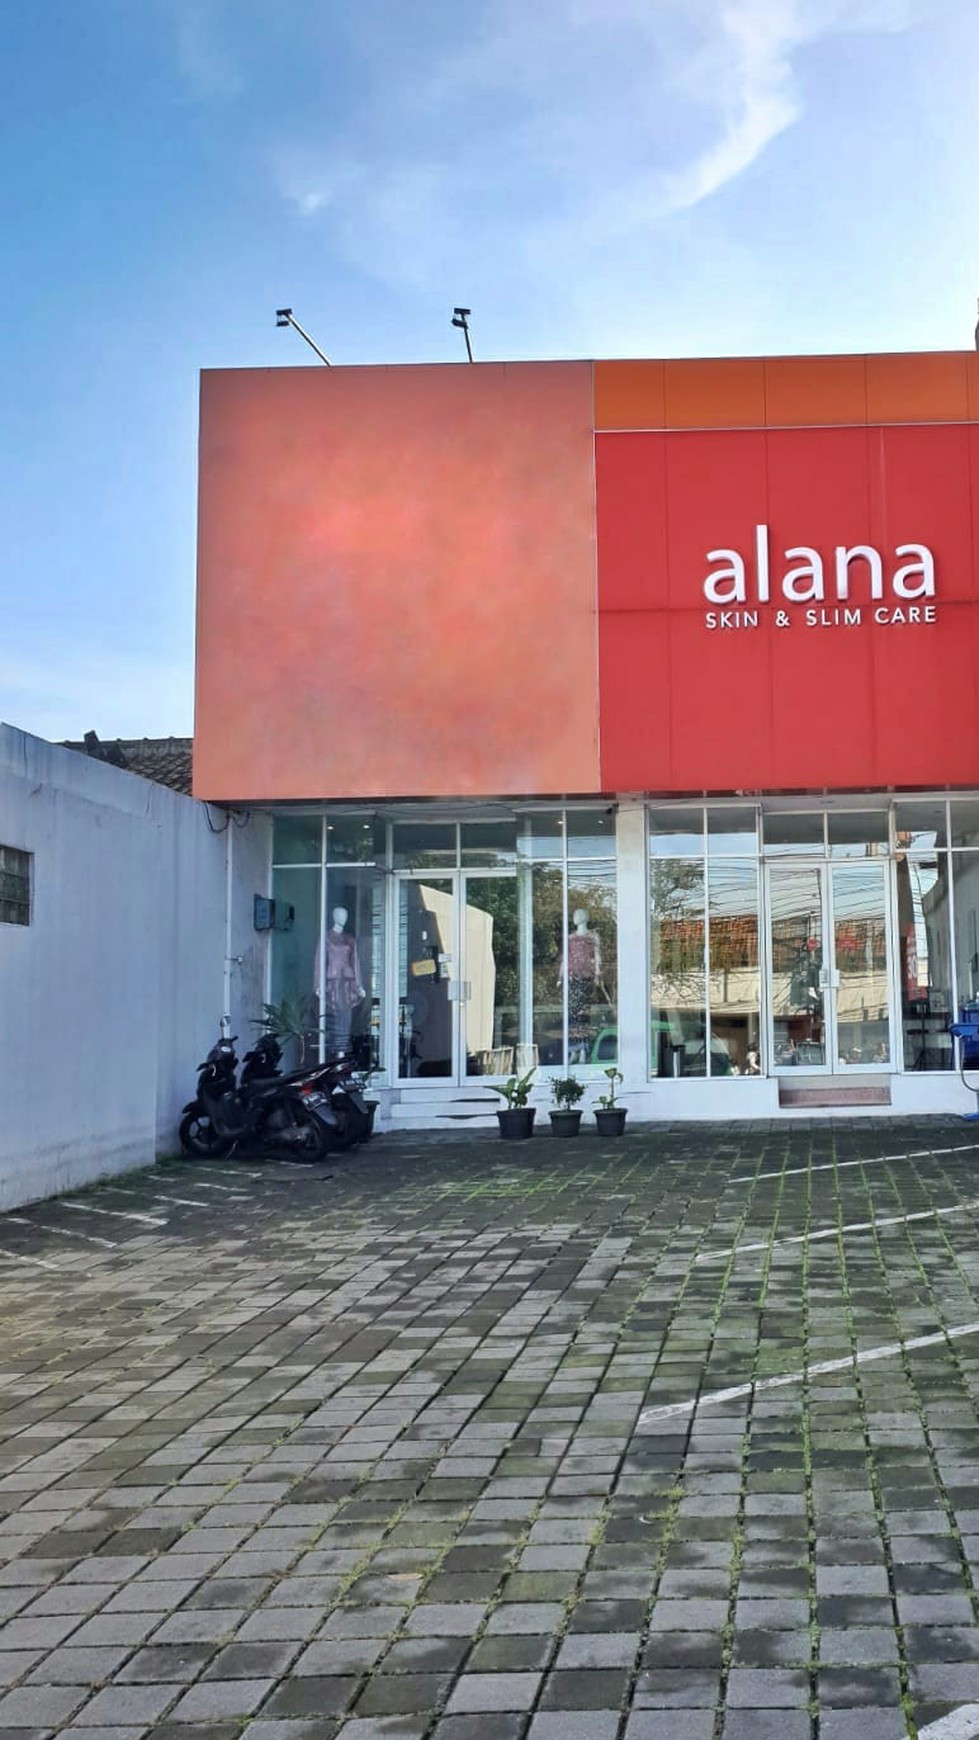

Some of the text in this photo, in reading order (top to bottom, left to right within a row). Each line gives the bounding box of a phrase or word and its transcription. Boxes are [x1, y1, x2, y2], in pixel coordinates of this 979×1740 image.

[703, 524, 936, 604] alana
[705, 605, 936, 629] SKIN & SLIM CARE
